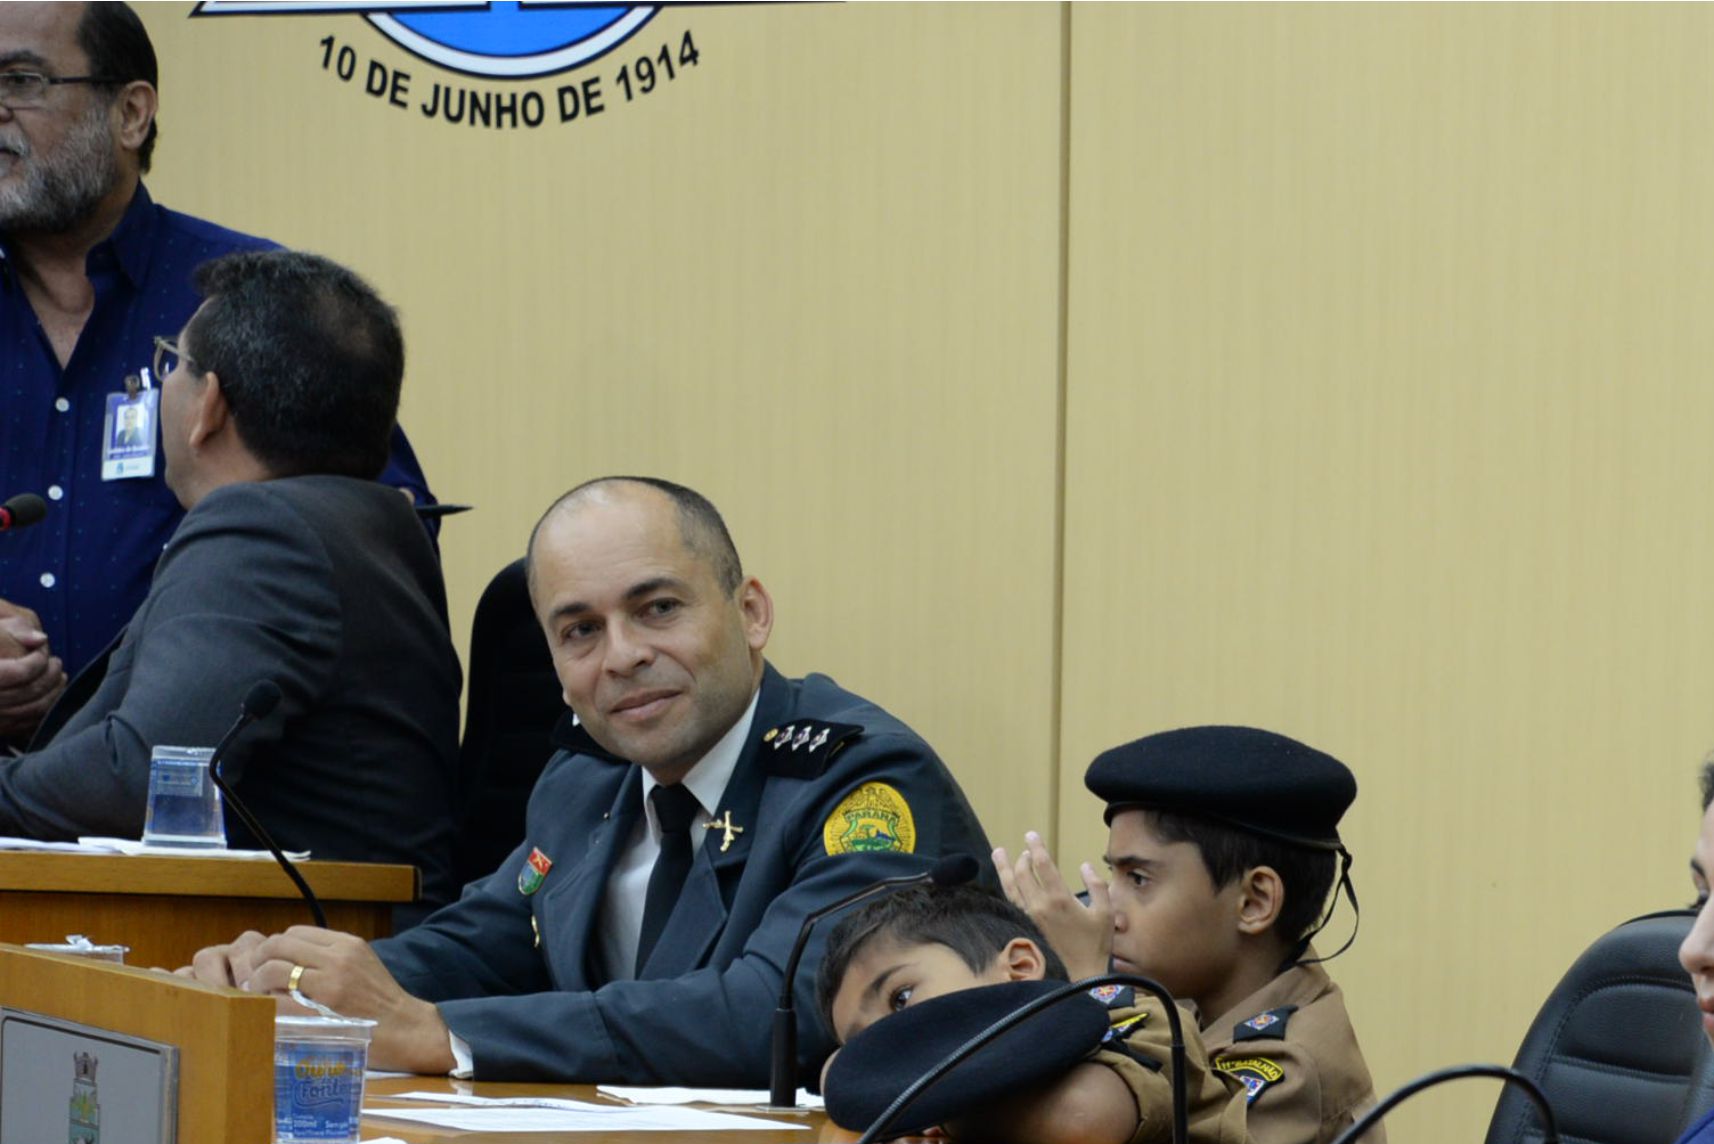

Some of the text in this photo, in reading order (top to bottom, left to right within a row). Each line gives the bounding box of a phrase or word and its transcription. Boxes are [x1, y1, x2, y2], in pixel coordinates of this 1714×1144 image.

[319, 30, 700, 130] 10 DE JUNHO DE 1914
